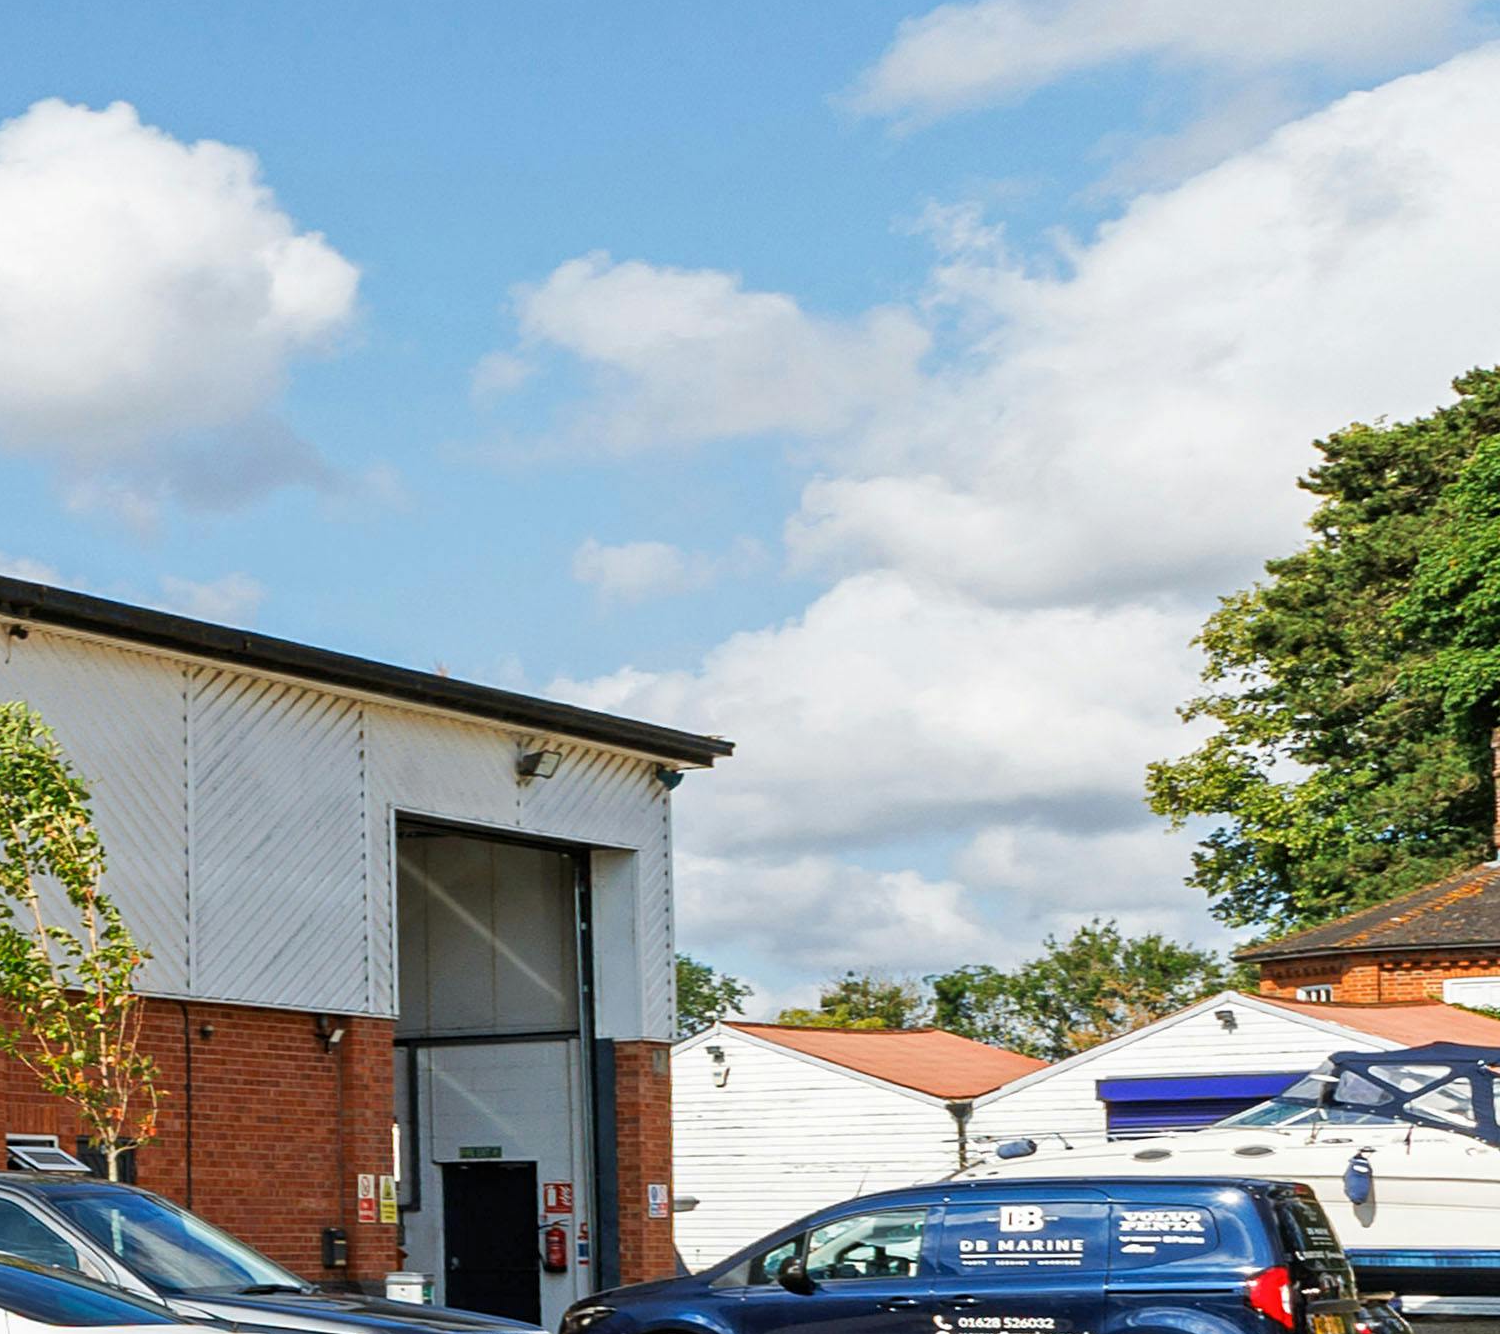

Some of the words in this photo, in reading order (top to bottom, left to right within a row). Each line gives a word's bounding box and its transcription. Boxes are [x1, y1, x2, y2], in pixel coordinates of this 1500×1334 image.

[999, 1205, 1044, 1233] DB
[1121, 1211, 1201, 1222] VOLVO
[1119, 1221, 1205, 1232] PENTA
[959, 1239, 989, 1252] DB
[997, 1239, 1084, 1252] MARINE
[957, 1317, 1001, 1329] 01628
[1003, 1317, 1055, 1329] 526032
